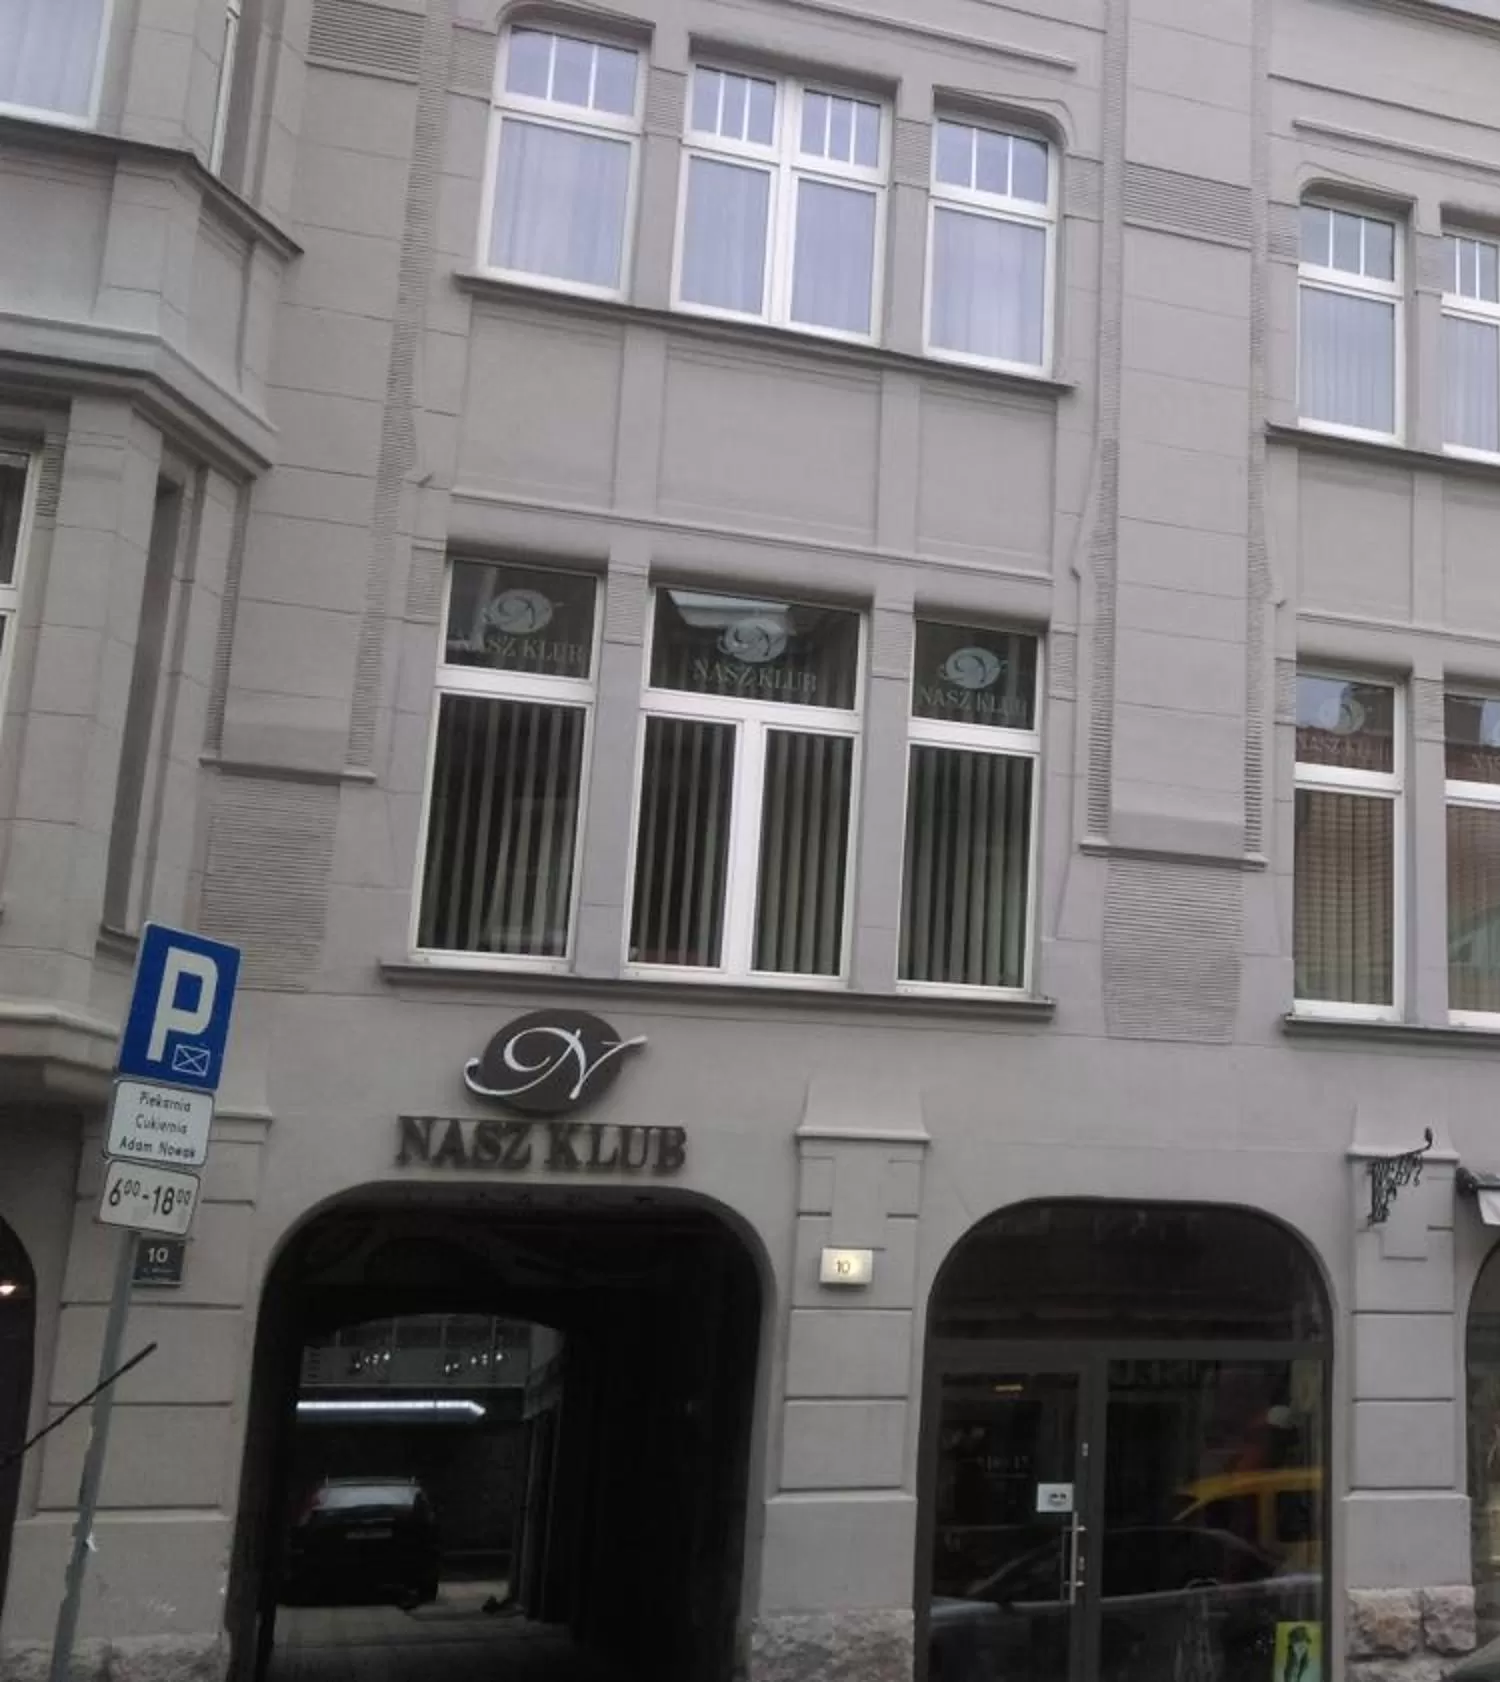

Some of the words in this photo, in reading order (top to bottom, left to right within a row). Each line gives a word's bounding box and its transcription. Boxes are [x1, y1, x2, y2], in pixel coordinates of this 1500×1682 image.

[146, 946, 218, 1063] P
[120, 1135, 152, 1152] Adam
[396, 1115, 532, 1169] NASZ
[545, 1121, 687, 1175] KLUB
[147, 1247, 169, 1263] 10
[836, 1259, 851, 1273] 10
